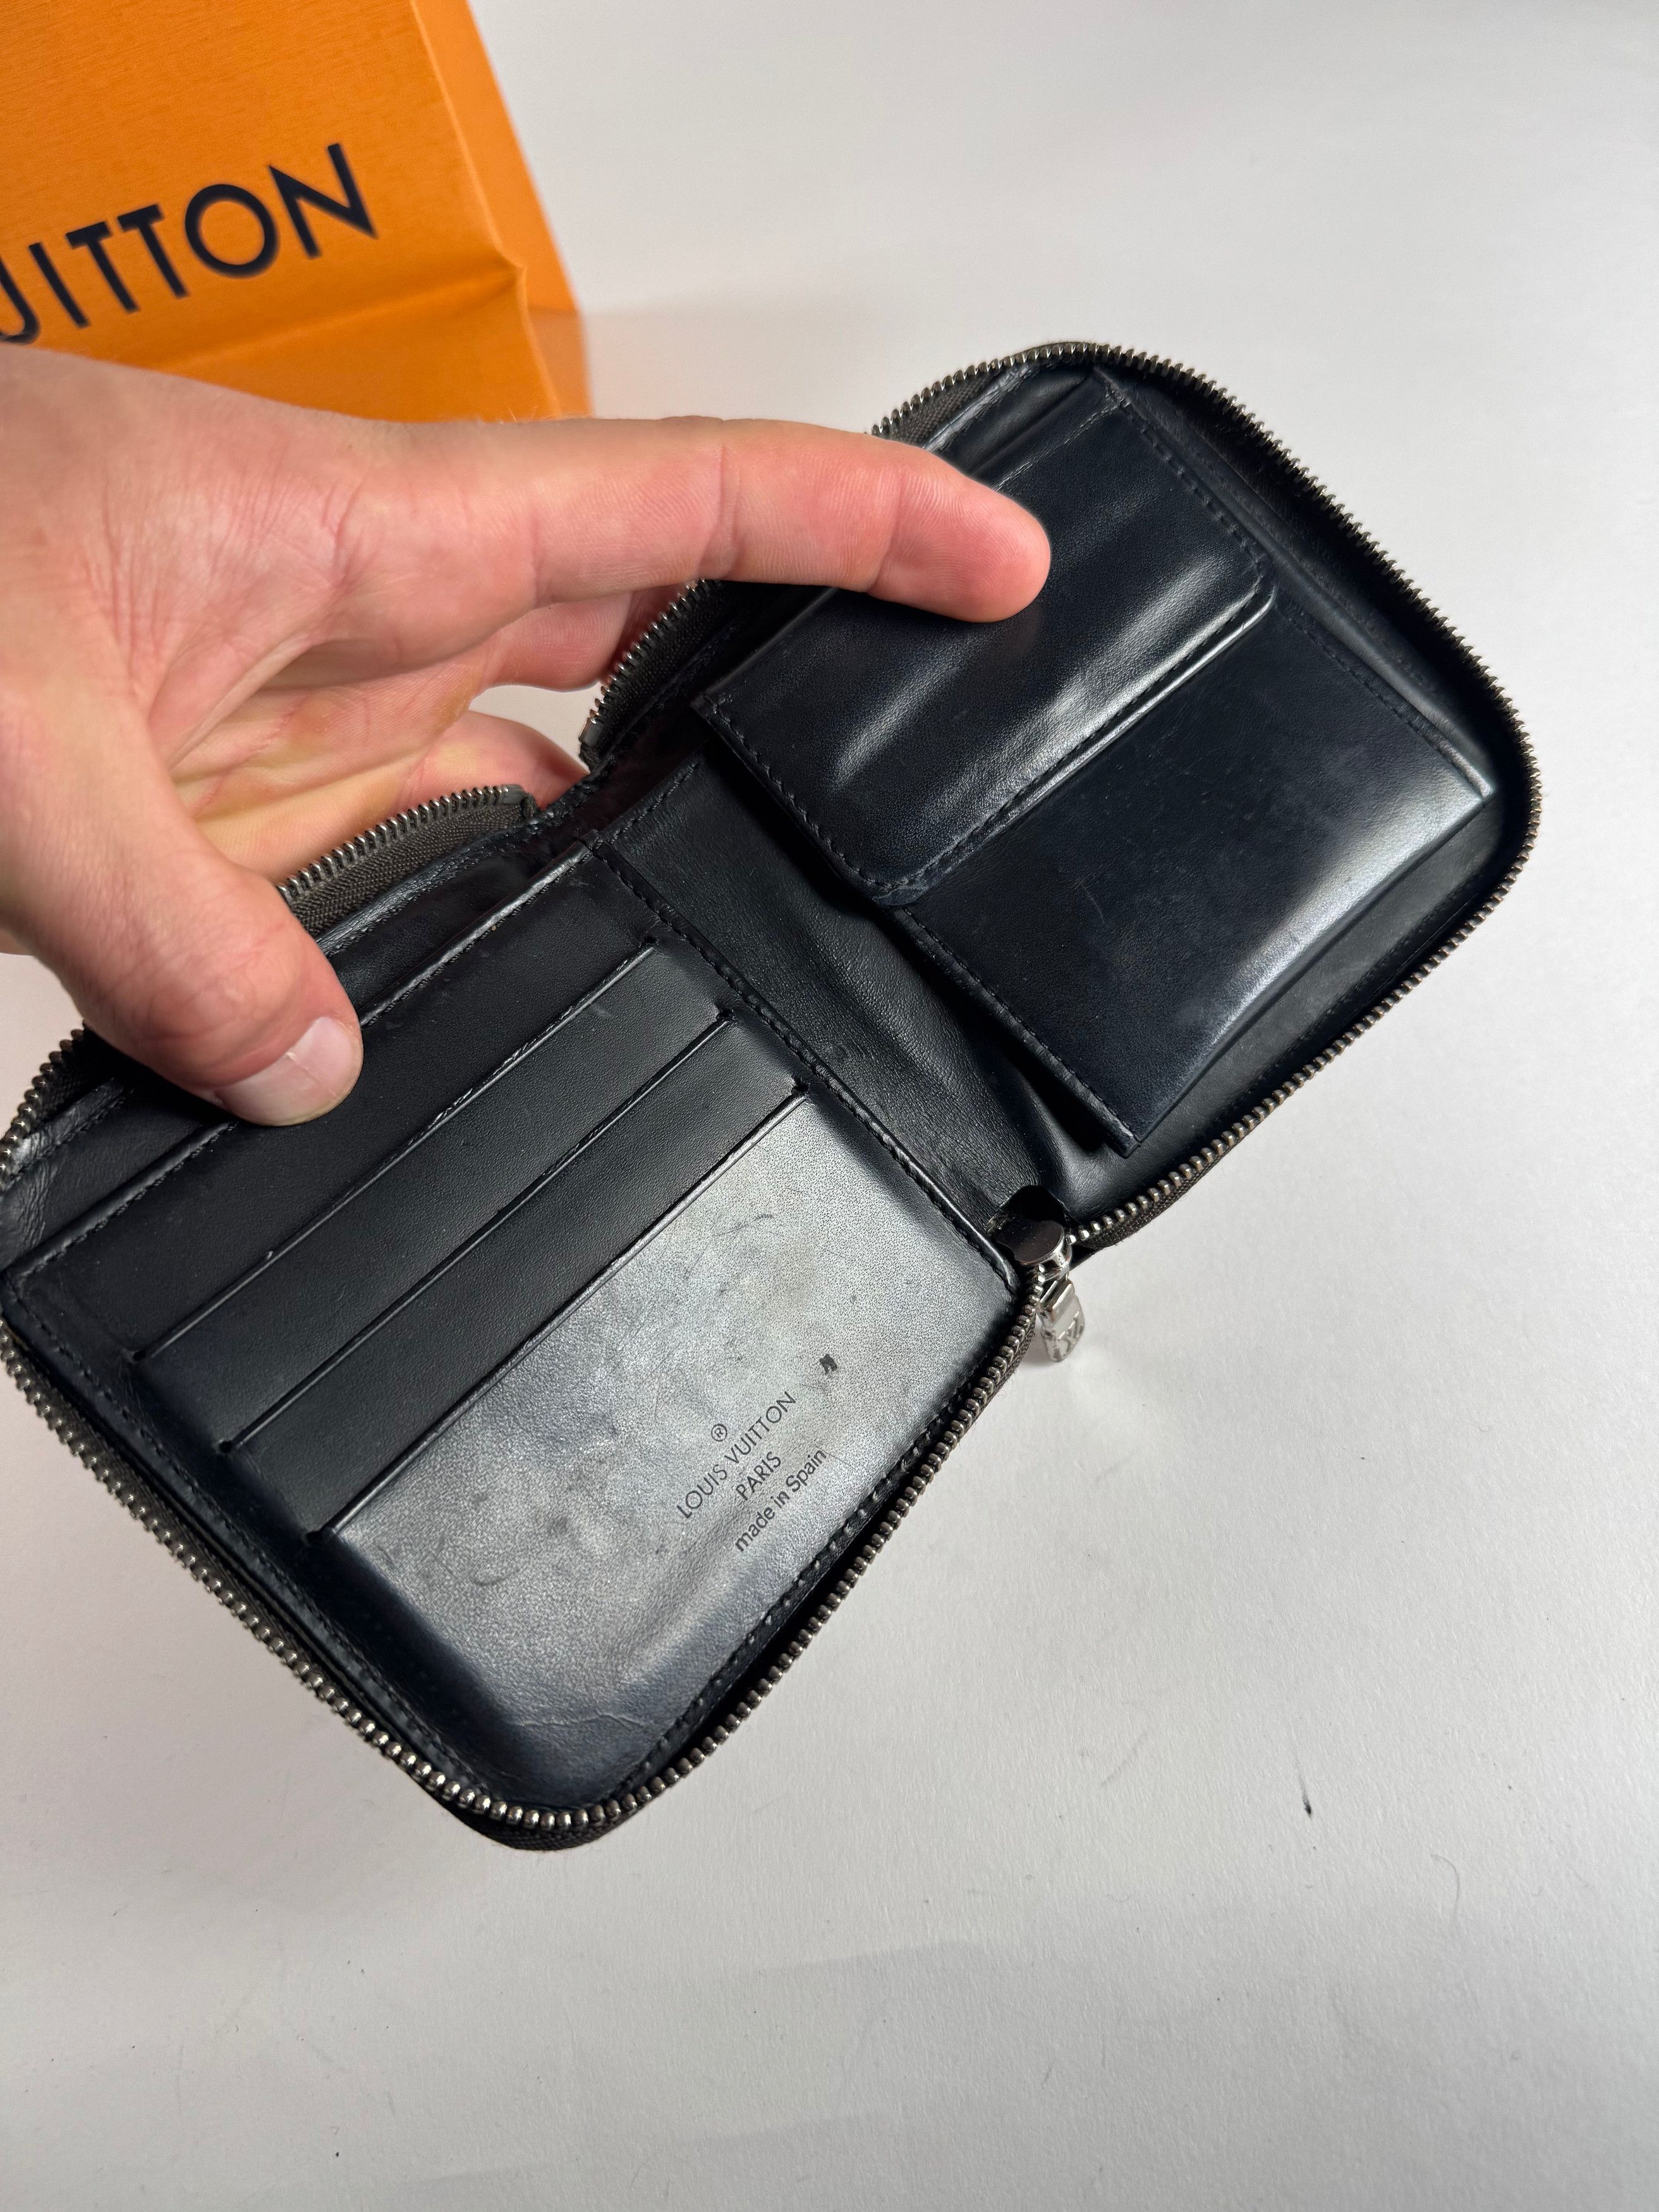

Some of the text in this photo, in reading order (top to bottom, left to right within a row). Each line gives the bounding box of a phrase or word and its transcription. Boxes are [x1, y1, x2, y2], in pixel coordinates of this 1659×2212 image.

[676, 1390, 796, 1519] LOUIS VUITTON
[734, 1449, 827, 1552] made in Spain
[735, 1451, 781, 1501] PARIS
